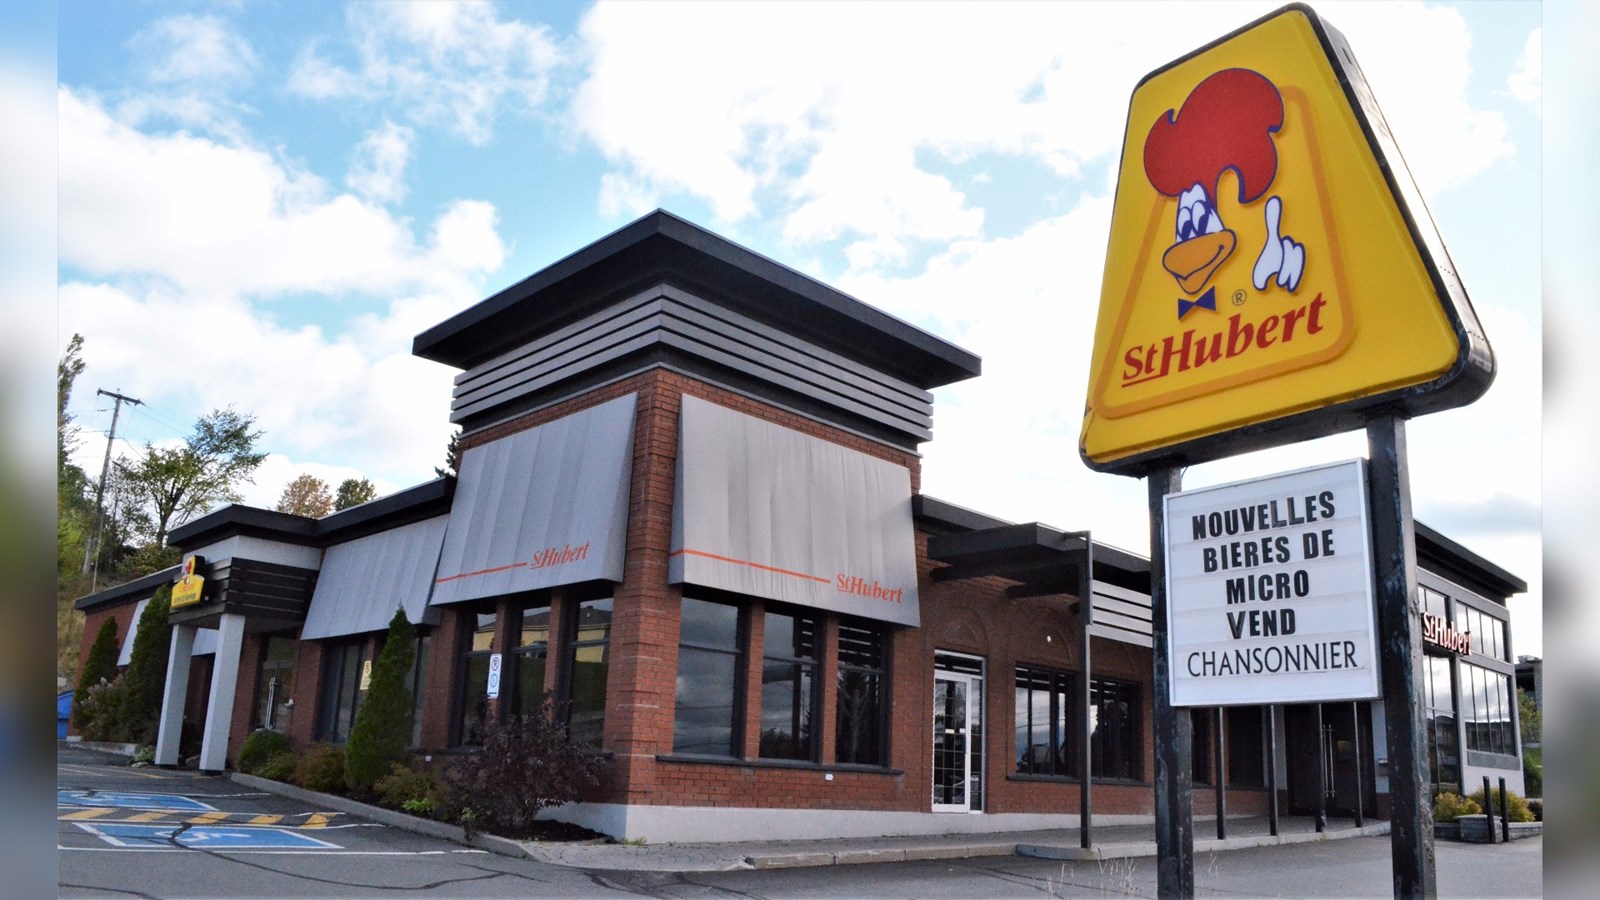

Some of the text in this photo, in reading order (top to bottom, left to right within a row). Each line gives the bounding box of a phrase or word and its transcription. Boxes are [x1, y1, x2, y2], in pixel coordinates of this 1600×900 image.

[1192, 490, 1336, 541] NOUVELLES
[1203, 529, 1335, 573] BIERES DE
[1226, 569, 1310, 605] MICRO
[1226, 608, 1296, 640] VEND
[1187, 640, 1358, 677] CHANSONNIER
